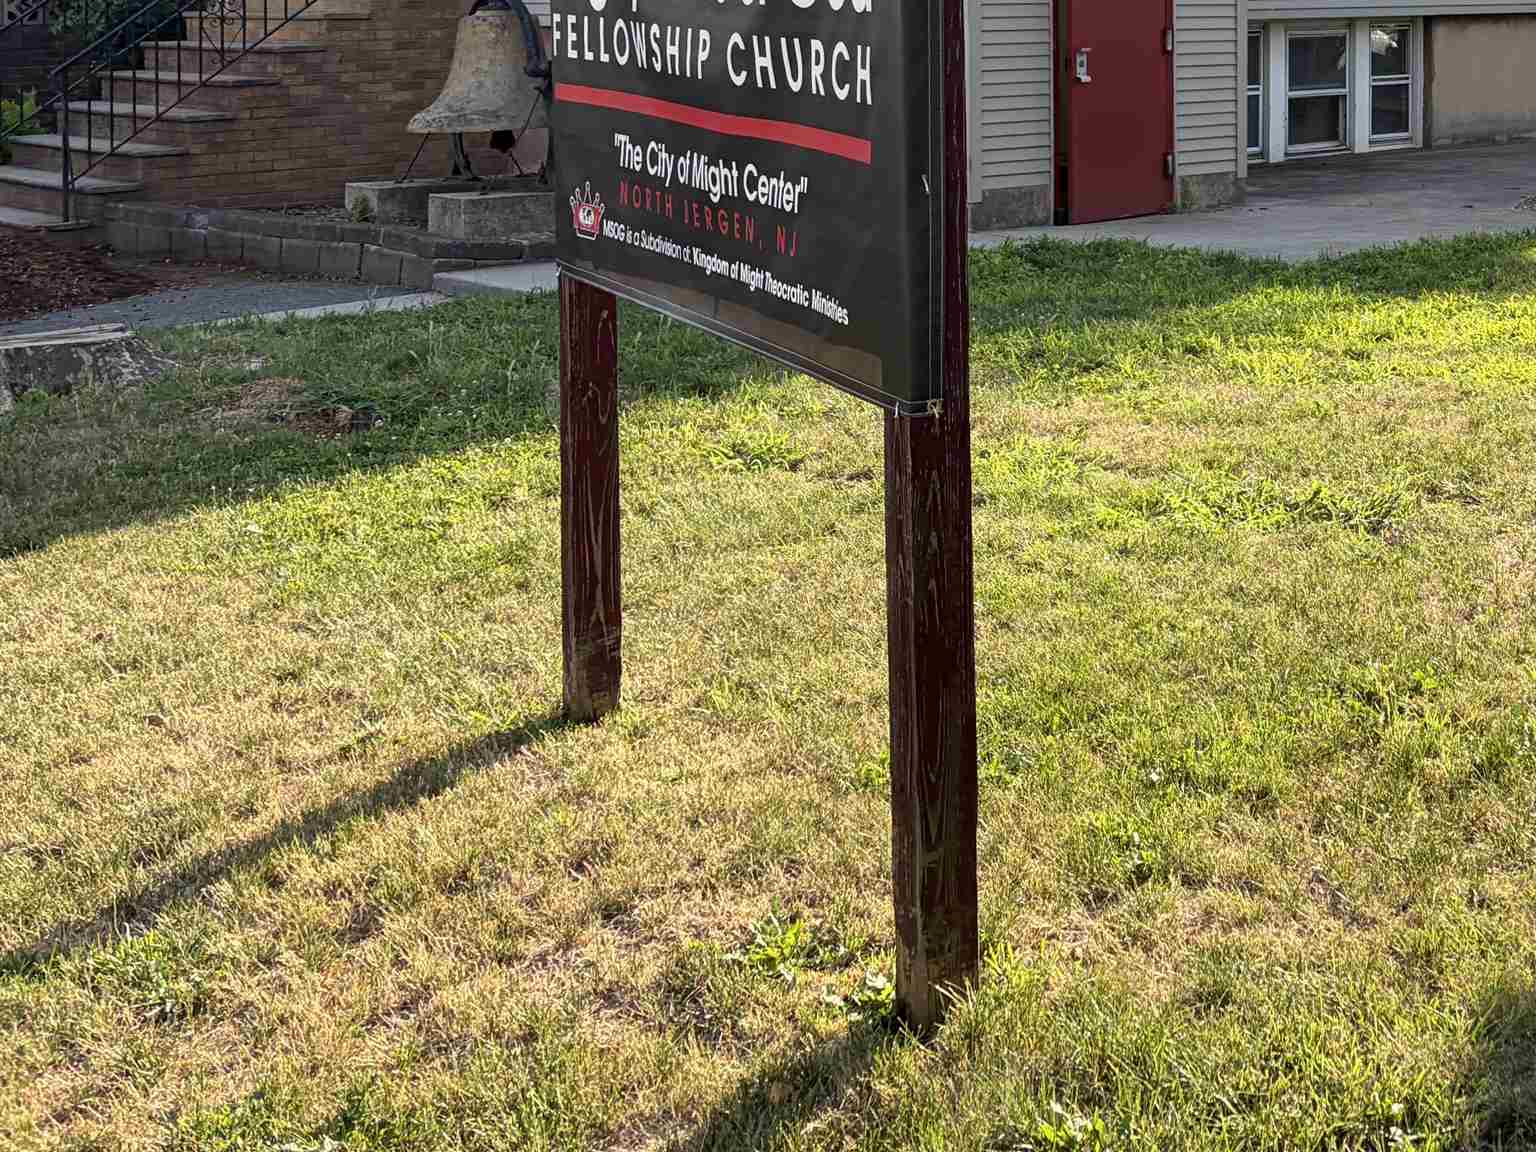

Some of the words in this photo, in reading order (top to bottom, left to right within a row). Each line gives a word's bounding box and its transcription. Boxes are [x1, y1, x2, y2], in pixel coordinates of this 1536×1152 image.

[553, 13, 711, 79] FELLOWSHIP
[726, 32, 873, 105] CHURCH
[614, 132, 643, 172] "The
[646, 140, 674, 187] City
[677, 150, 691, 185] of
[691, 151, 738, 203] Might
[743, 163, 808, 213] Center"
[619, 180, 673, 220] NORTH
[776, 224, 799, 256] NJ
[625, 226, 633, 244] is
[633, 233, 640, 246] a
[640, 229, 682, 259] Subdivision
[693, 247, 729, 275] Kingdom
[730, 260, 739, 280] of
[740, 262, 764, 291] Might
[764, 271, 809, 307] Theocratic
[812, 289, 849, 325] Ministries
